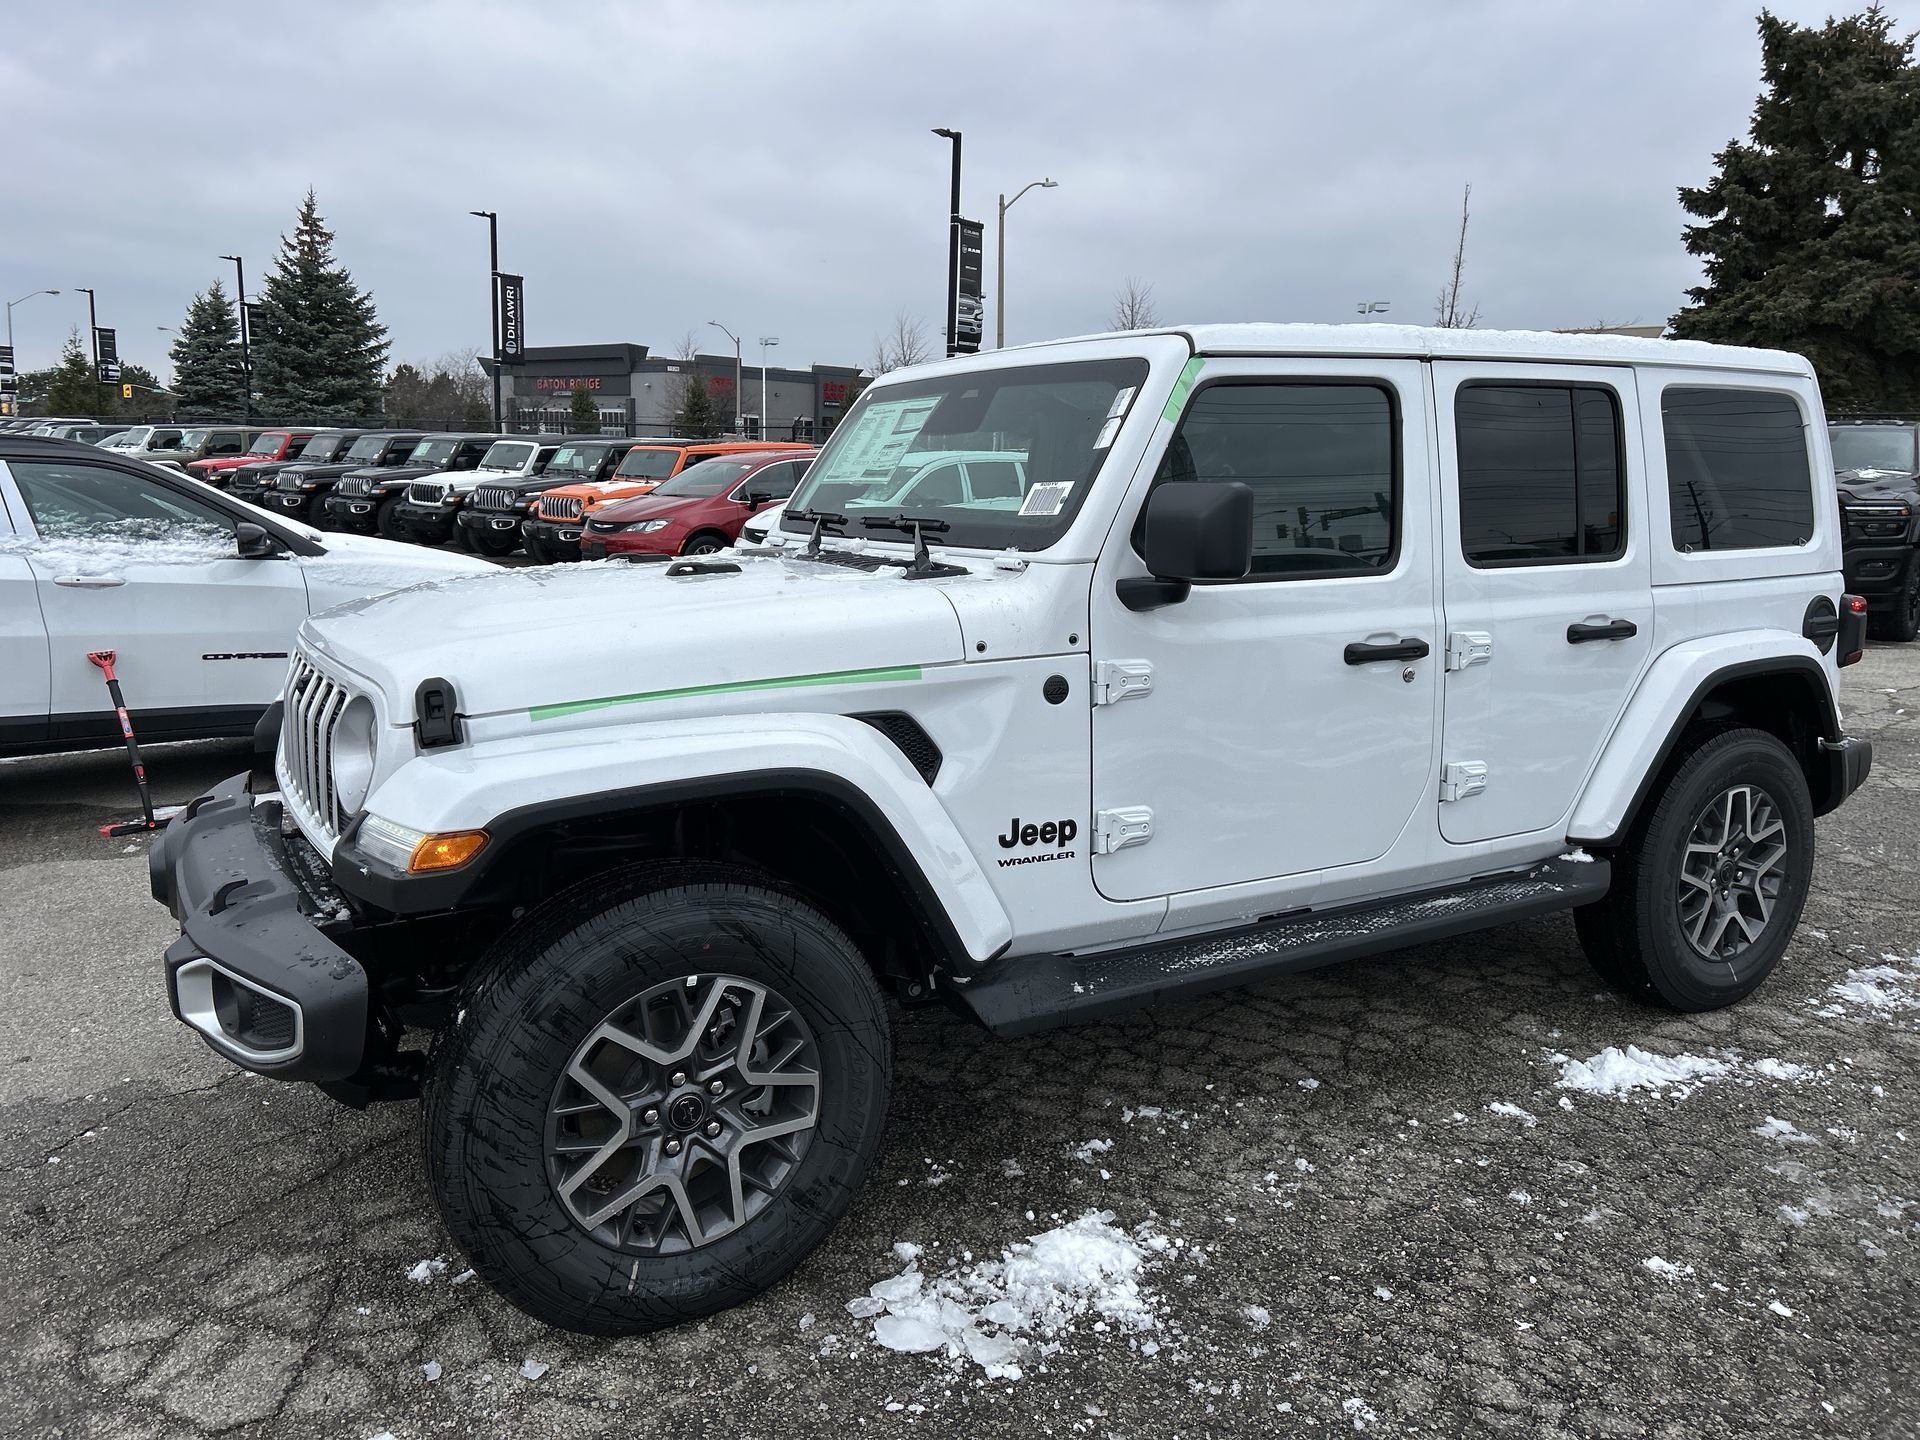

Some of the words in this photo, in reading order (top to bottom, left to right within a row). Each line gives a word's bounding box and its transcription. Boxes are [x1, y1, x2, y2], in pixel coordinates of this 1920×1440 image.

[506, 285, 515, 339] DILAWRI
[998, 817, 1077, 849] Jeep
[998, 851, 1075, 867] WRANGLER
